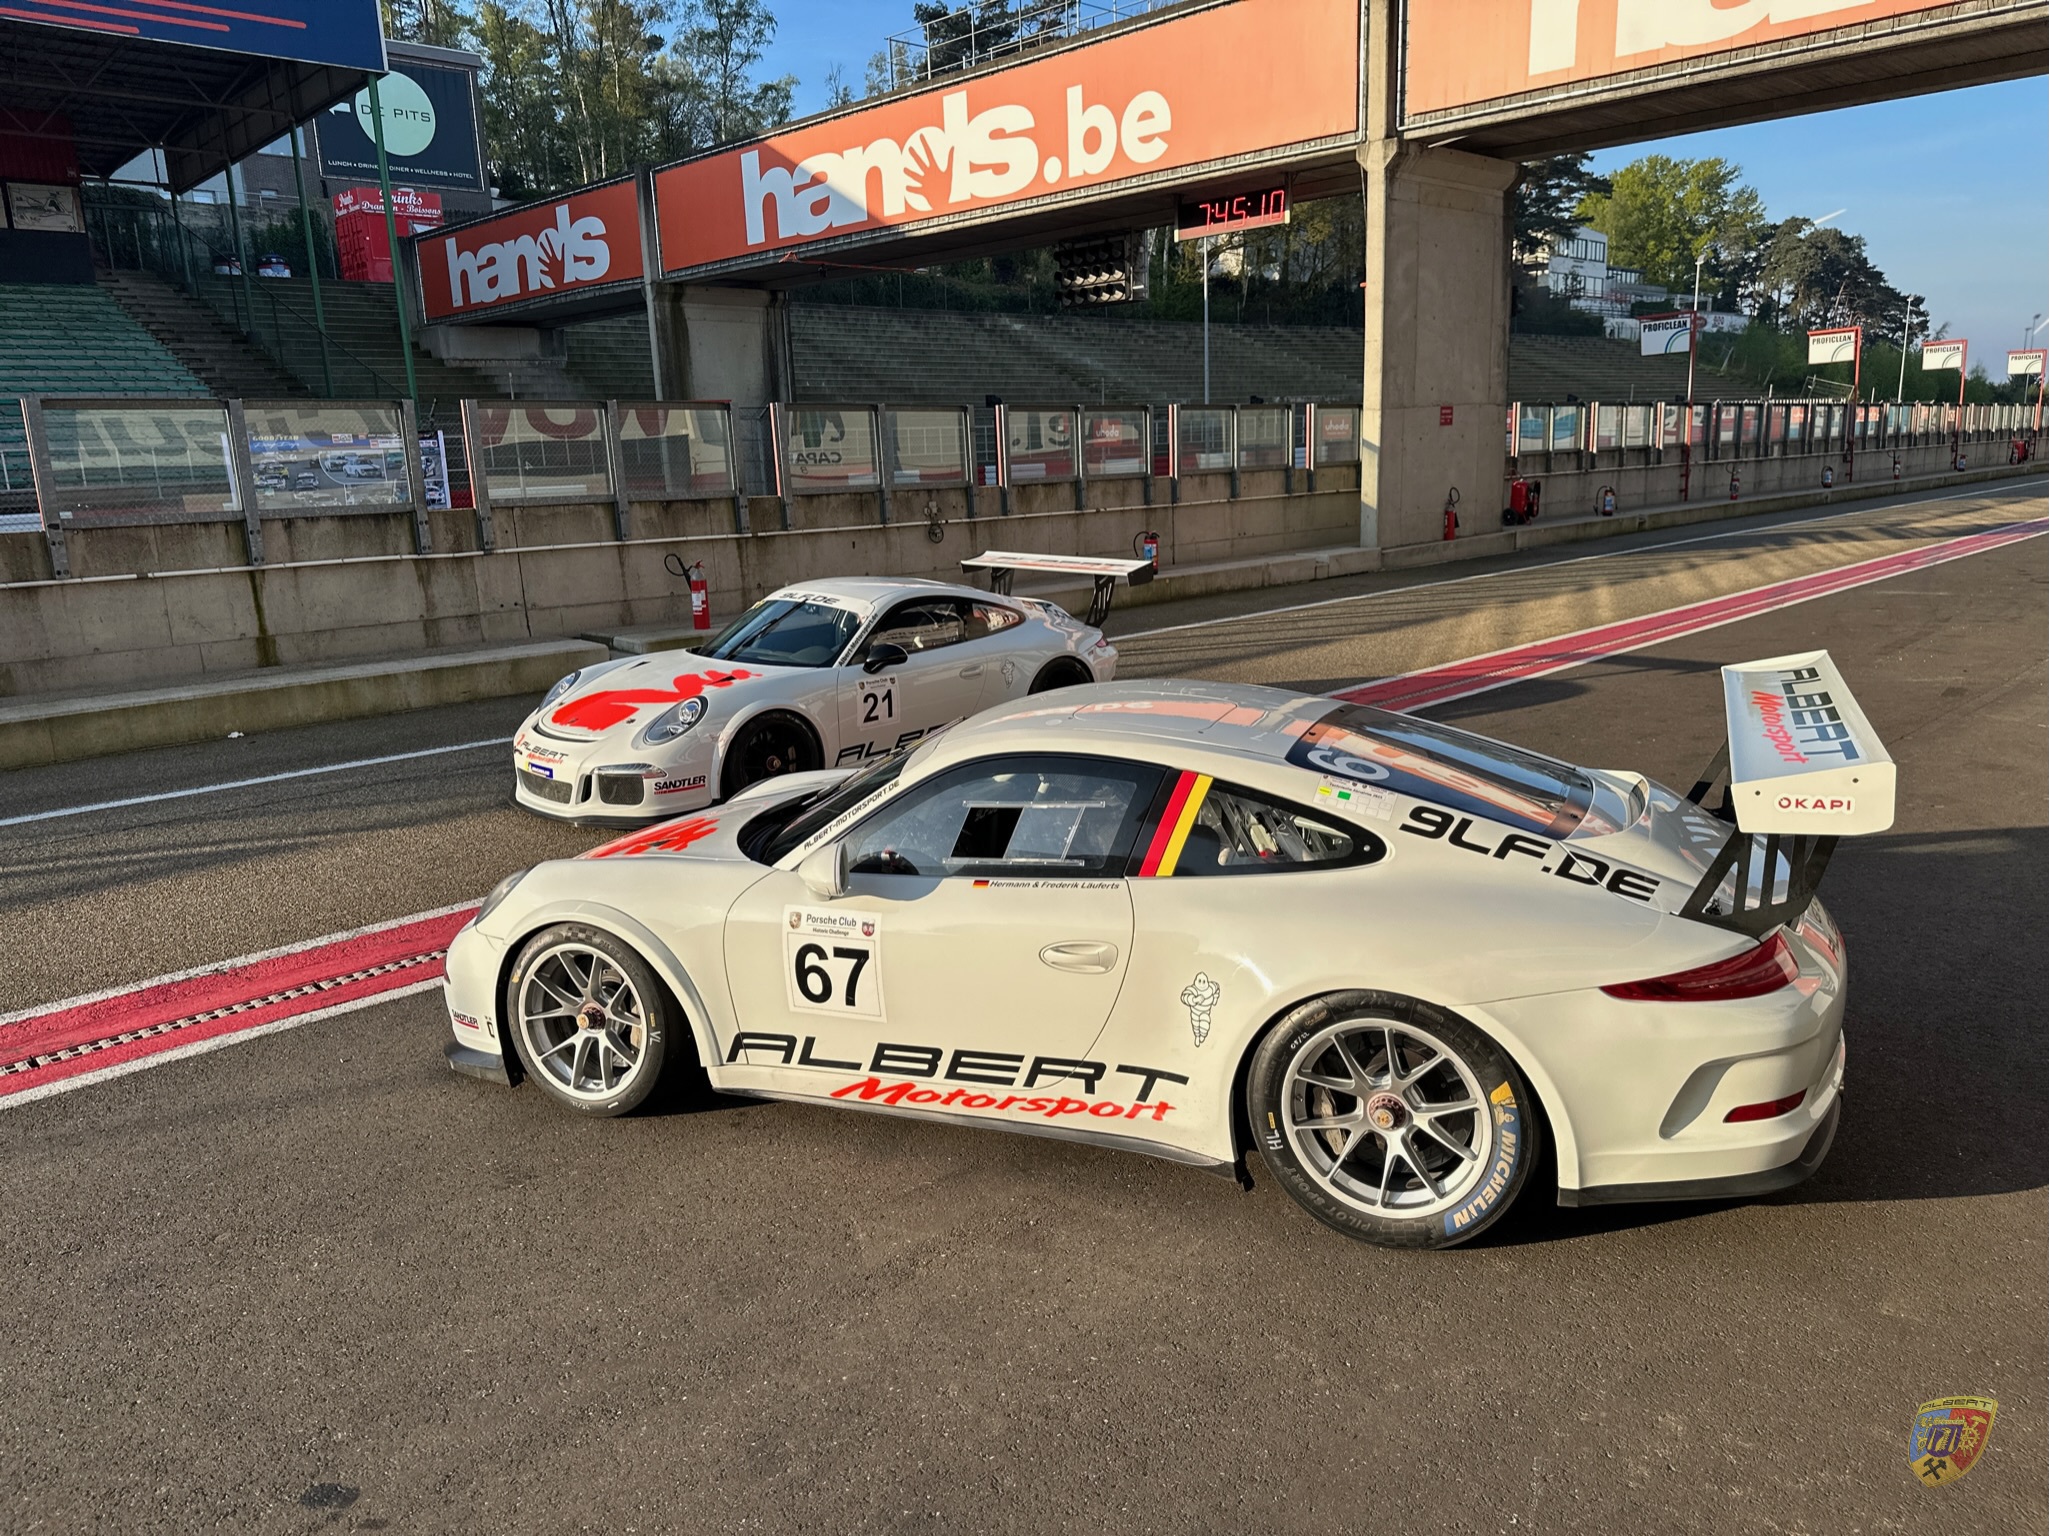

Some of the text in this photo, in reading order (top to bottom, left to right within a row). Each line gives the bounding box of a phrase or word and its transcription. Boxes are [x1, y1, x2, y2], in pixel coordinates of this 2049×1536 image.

[393, 108, 431, 123] PITS
[327, 159, 353, 168] LUNCH
[388, 165, 410, 173] DINER
[414, 168, 448, 177] WELLNESS
[453, 172, 474, 180] HOTEL
[740, 84, 1172, 246] hands.be
[406, 204, 441, 216] Boissons
[1199, 189, 1284, 231] 7:45:10
[445, 204, 610, 308] hands
[1643, 320, 1687, 333] PROFICLEAN
[1811, 334, 1852, 345] PROFICLEAN
[1926, 345, 1961, 354] PROFICLEAN
[2011, 353, 2042, 361] PROFICLEAN
[863, 689, 893, 724] 21
[1777, 668, 1860, 760] ALBERT
[1751, 691, 1809, 764] Motorsport
[521, 741, 569, 760] ALBERT
[654, 775, 706, 791] SANDTLER
[1778, 797, 1851, 810] OKAPI
[803, 779, 900, 851] ALBERT-MOTORSPORT.DE
[1399, 806, 1660, 902] 9LF.DE
[1041, 881, 1079, 889] Frederik
[1081, 882, 1120, 890] Läuferts
[806, 914, 857, 928] Porsche Club
[812, 927, 850, 937] Historic Challenge
[795, 942, 869, 1007] 67
[726, 1031, 1190, 1103] ALBERT
[829, 1077, 1178, 1121] Motorsport
[1453, 1129, 1519, 1229] MICHELIN
